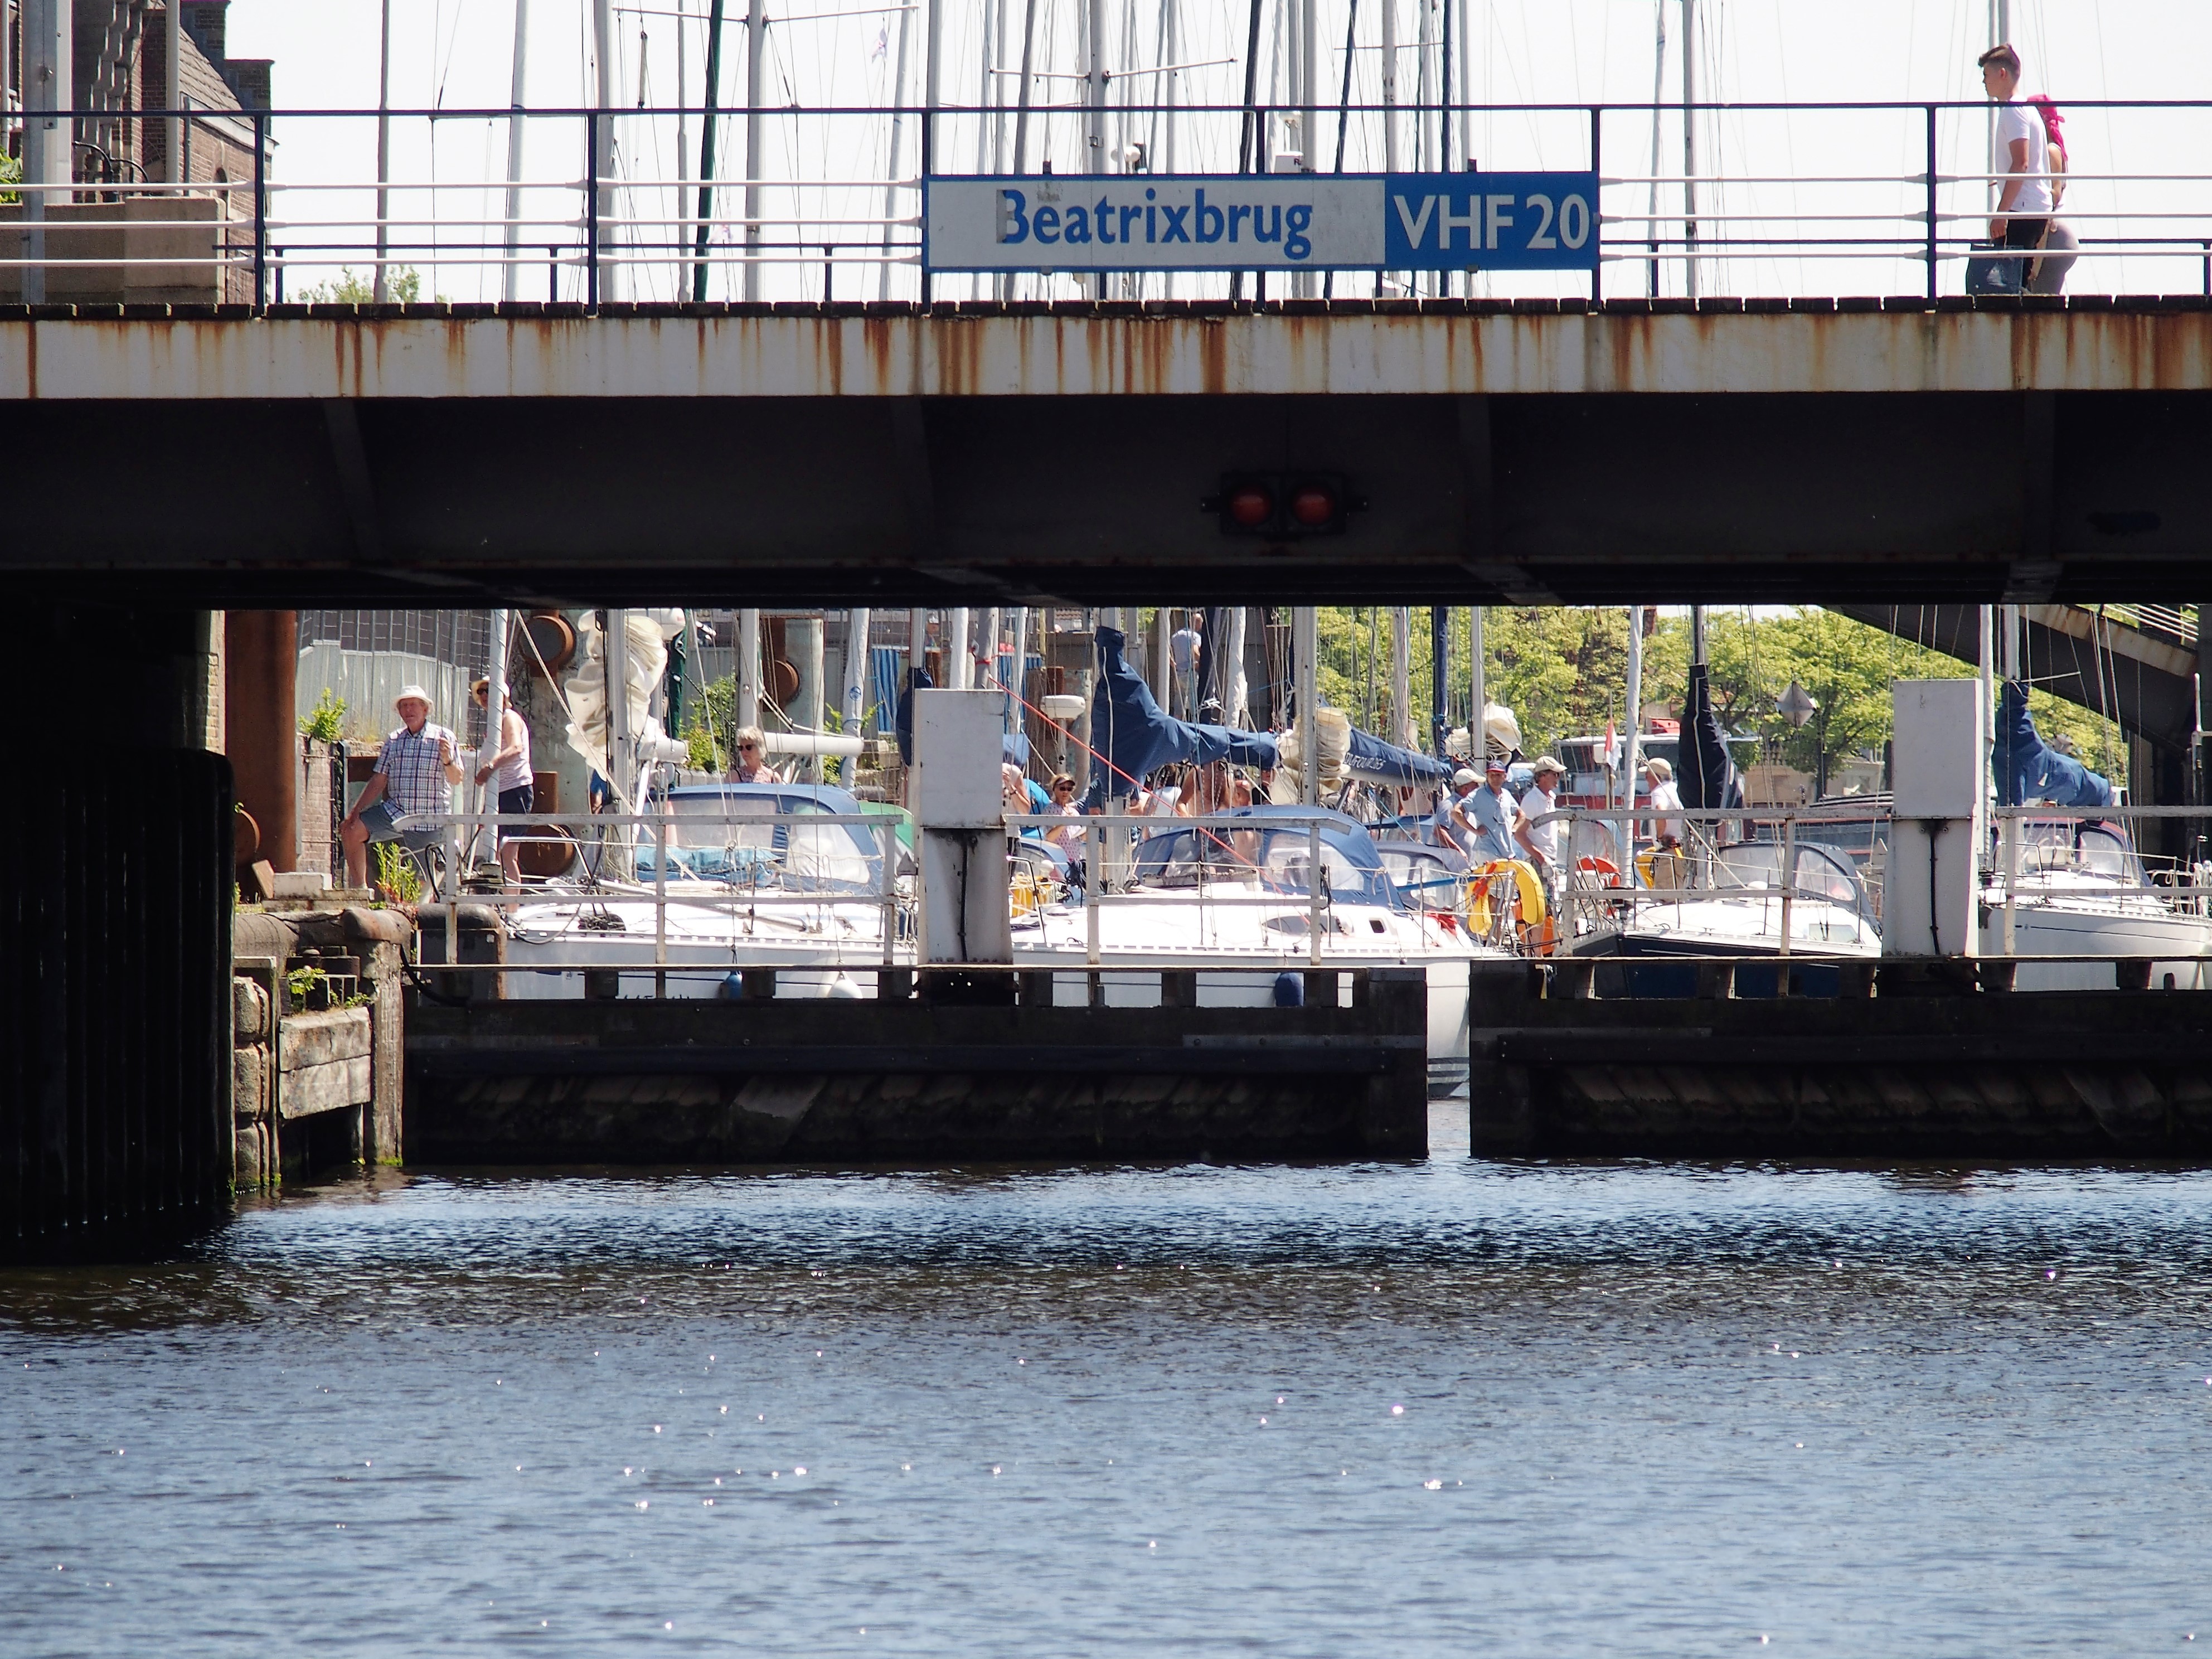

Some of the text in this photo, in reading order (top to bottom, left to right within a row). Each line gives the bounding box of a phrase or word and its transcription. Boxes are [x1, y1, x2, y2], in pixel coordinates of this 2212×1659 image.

[996, 187, 1312, 260] Beatrixbrug
[1393, 193, 1590, 250] VHF 20
